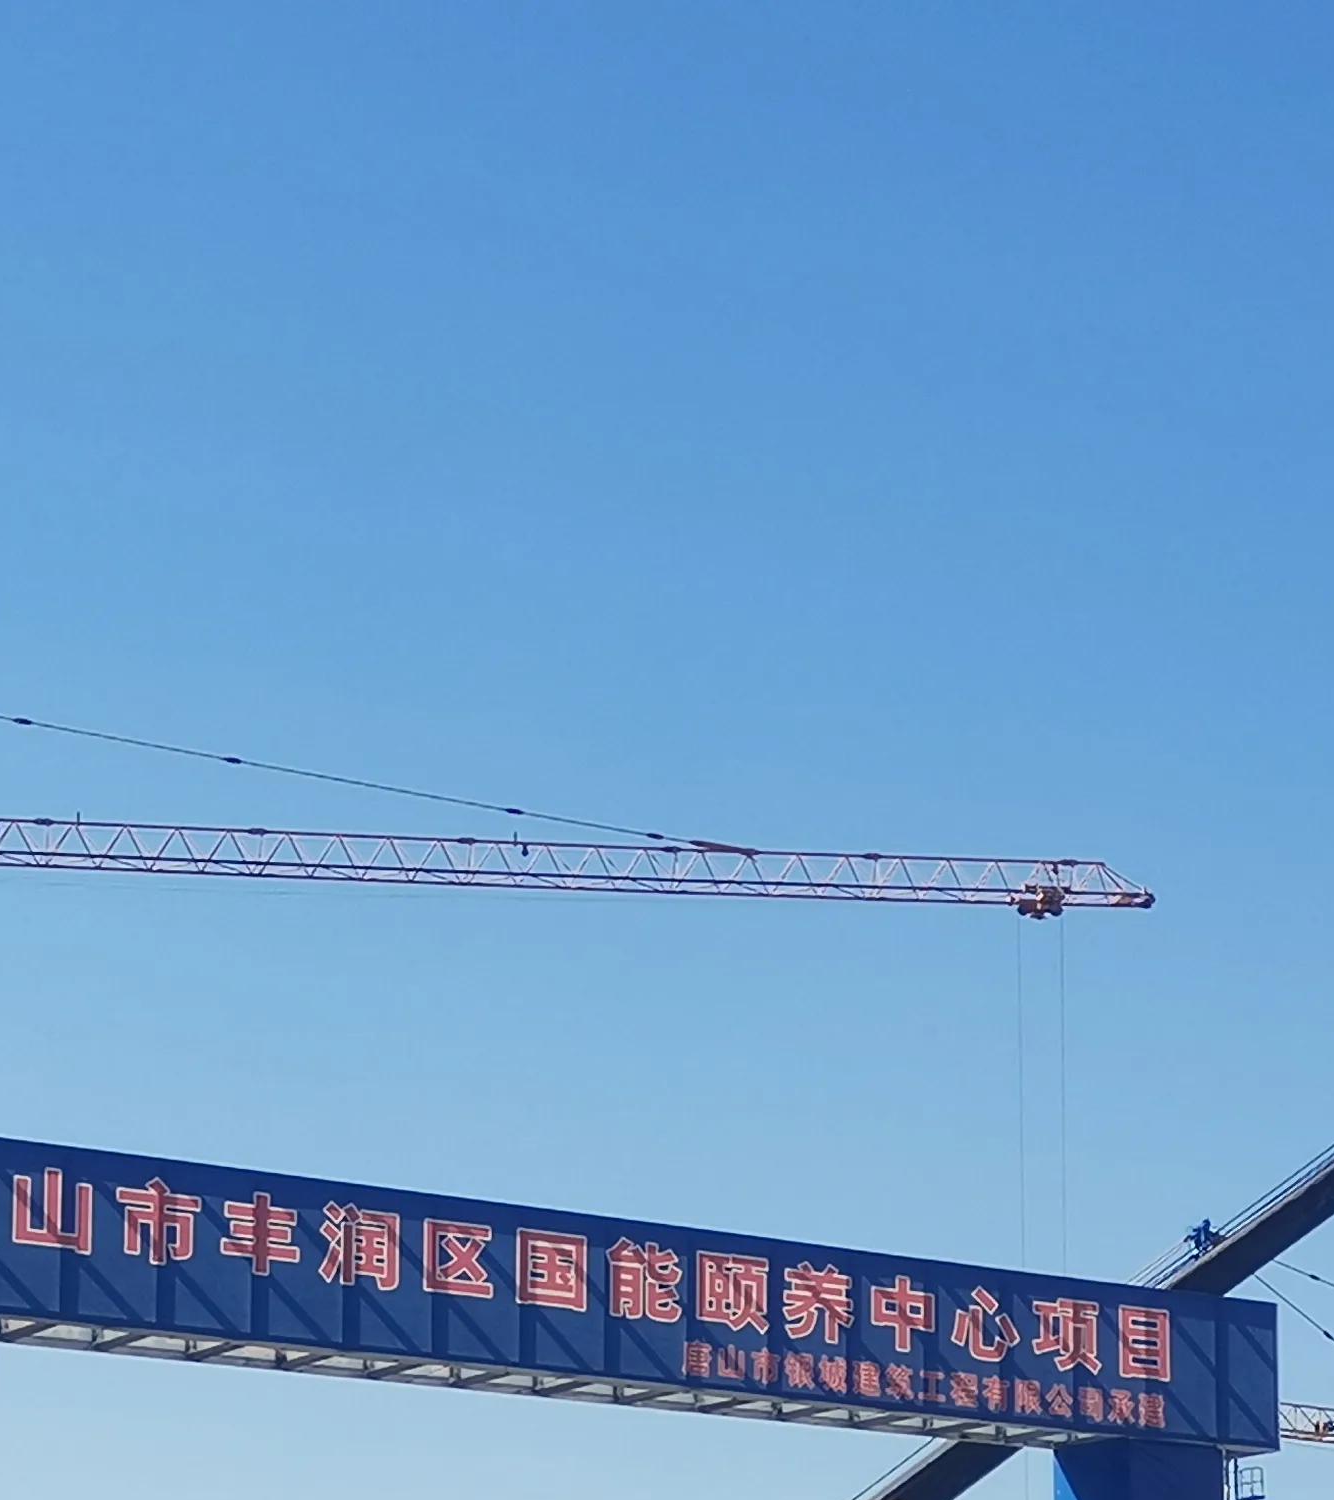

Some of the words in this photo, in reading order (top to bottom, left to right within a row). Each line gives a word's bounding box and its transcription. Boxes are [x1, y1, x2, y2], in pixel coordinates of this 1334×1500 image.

[681, 1339, 1166, 1429] 唐山市银城建筑工程有限公司承建
